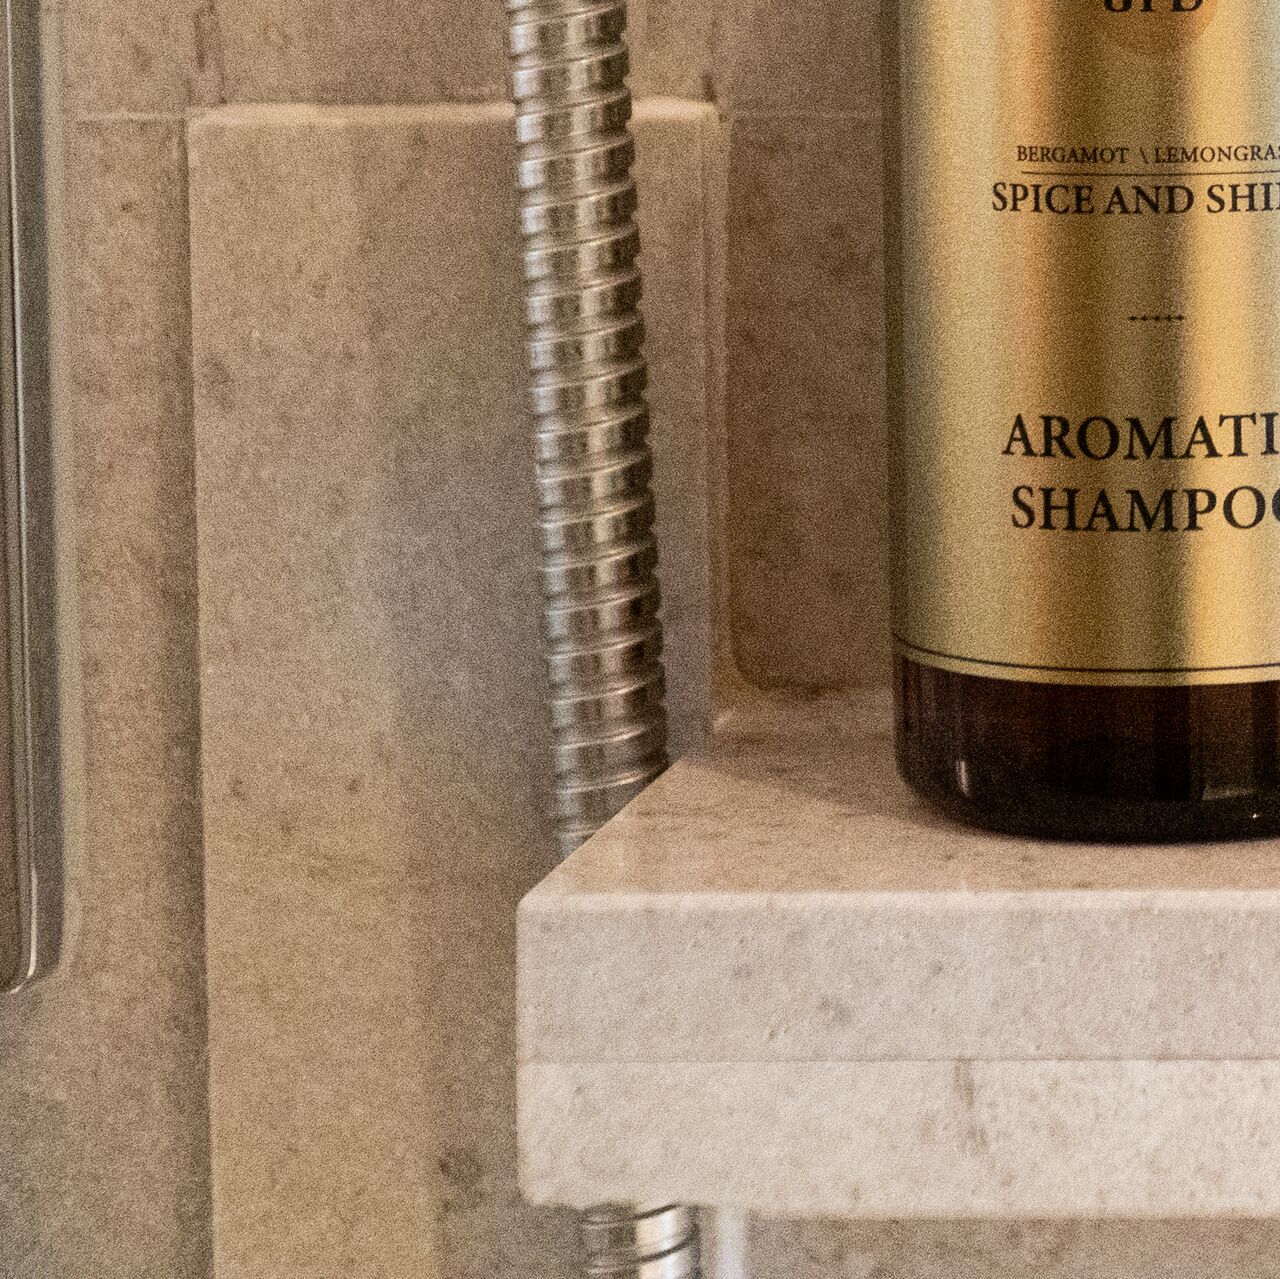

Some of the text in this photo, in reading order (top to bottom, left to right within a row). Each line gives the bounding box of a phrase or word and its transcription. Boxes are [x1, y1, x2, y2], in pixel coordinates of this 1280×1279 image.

[1016, 145, 1127, 164] BERGAMOT
[992, 182, 1094, 215] SPICE
[1103, 184, 1194, 215] AND
